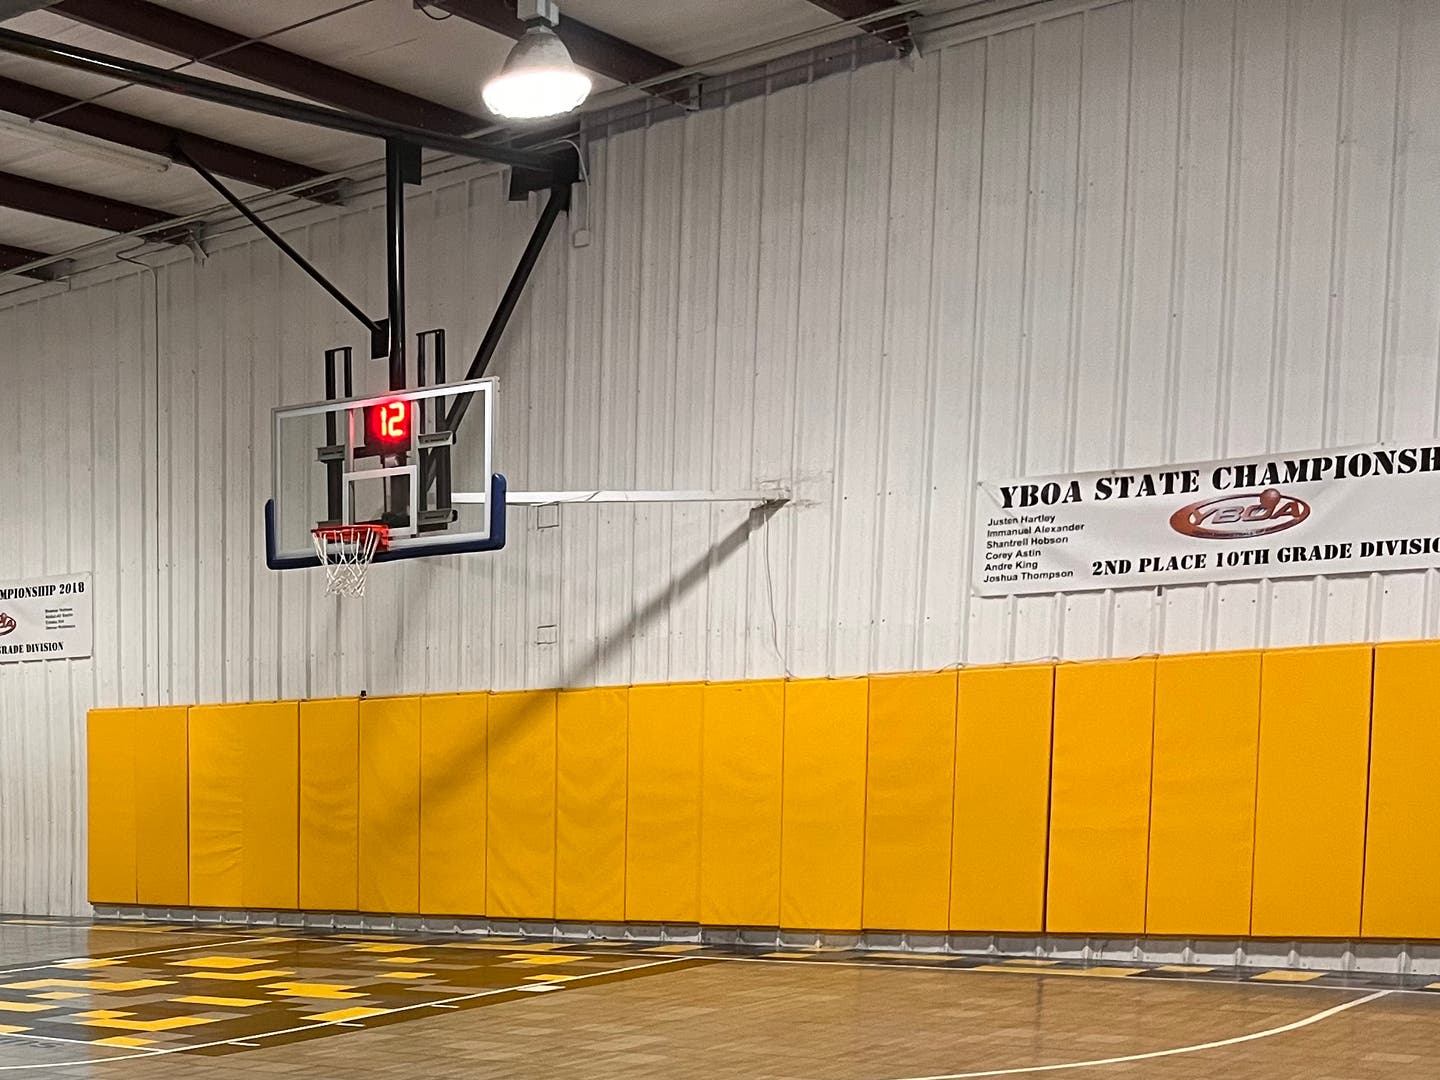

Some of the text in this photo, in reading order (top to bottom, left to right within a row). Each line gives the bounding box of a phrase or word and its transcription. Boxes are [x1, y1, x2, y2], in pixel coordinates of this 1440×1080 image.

[379, 401, 406, 437] 12
[1000, 481, 1083, 509] YBOA
[1094, 470, 1200, 501] STATE
[1020, 514, 1056, 524] Hartley
[987, 523, 1085, 538] Immanuel Alexander
[986, 536, 1068, 549] Shantrell Hobson
[985, 549, 1041, 560] Corey Astin
[1092, 560, 1131, 576] 2ND
[1138, 554, 1206, 573] PLACE
[1216, 548, 1269, 568] 10TH
[1277, 542, 1352, 564] GRADE
[984, 561, 1038, 571] Andre King
[983, 570, 1074, 583] Joshua Thompson
[59, 582, 85, 595] 2018
[26, 641, 64, 653] DIVISION
